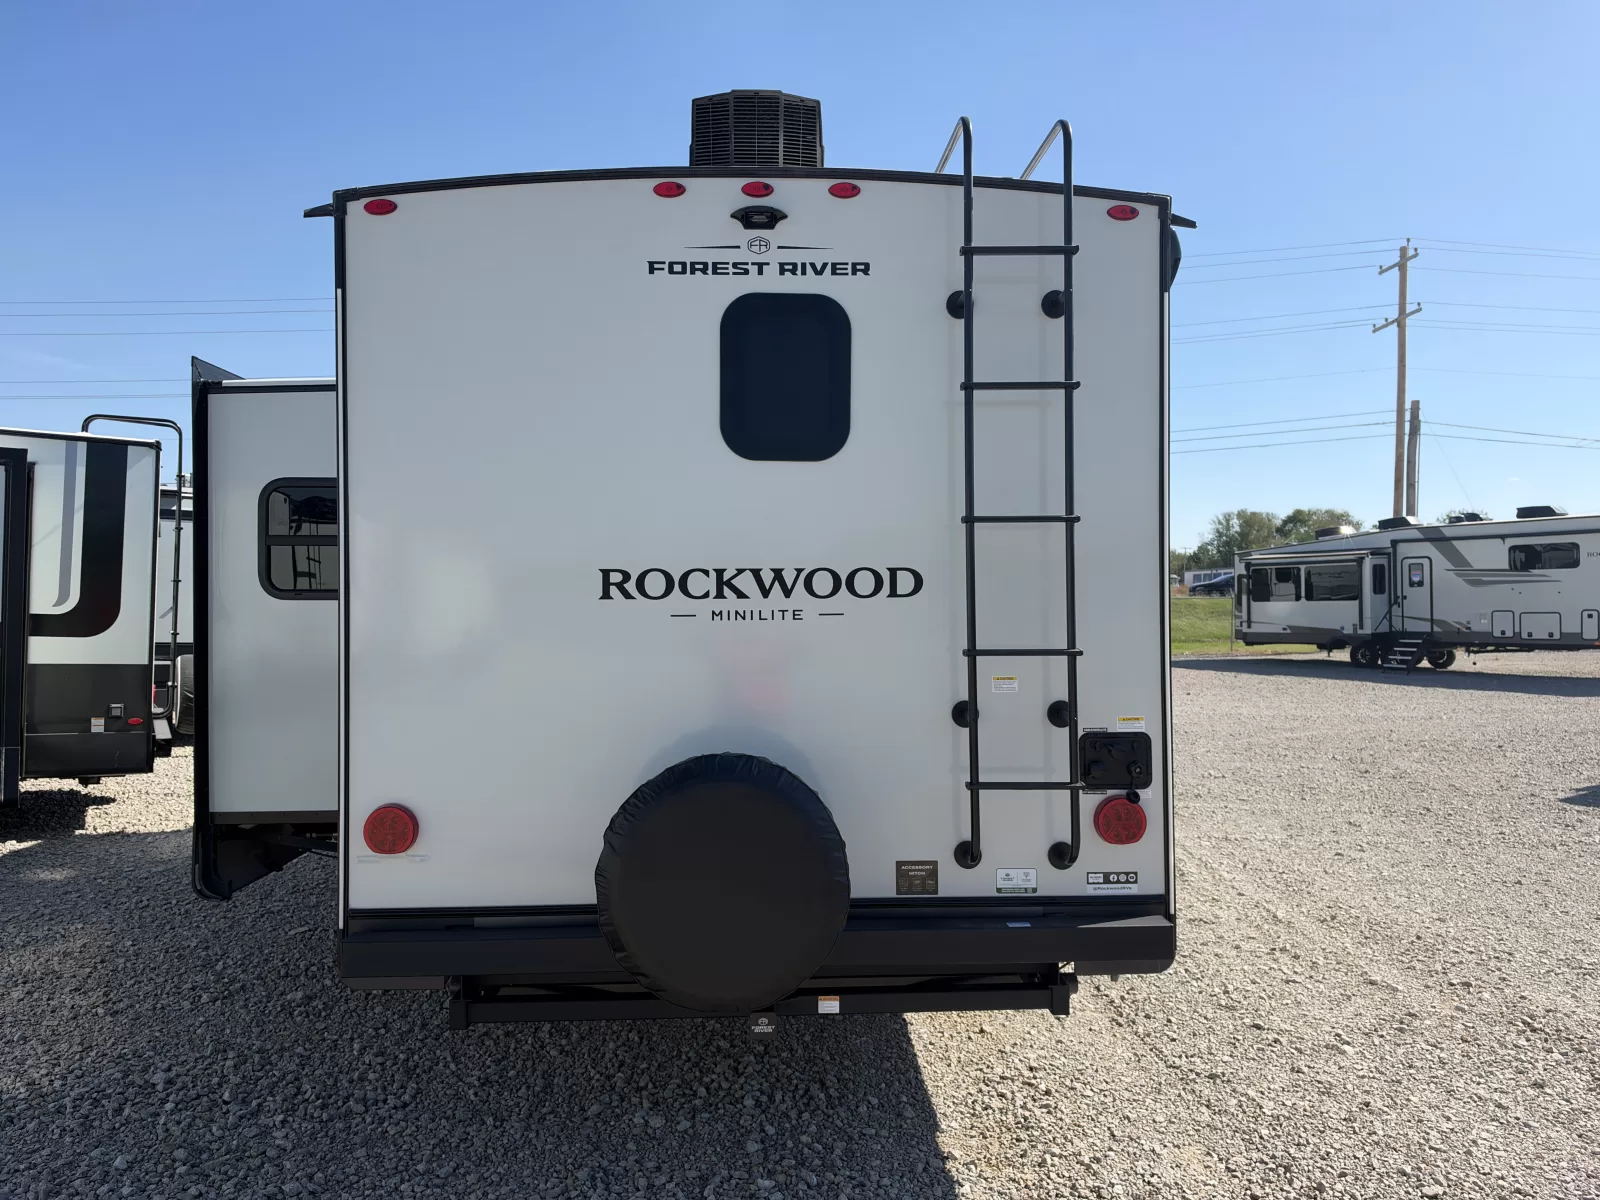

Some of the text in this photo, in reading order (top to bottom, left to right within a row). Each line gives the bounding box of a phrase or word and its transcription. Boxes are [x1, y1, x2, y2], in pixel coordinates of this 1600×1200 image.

[646, 260, 871, 276] FOREST RIVER
[598, 567, 924, 600] ROCKWOOD
[711, 609, 804, 621] MINILITE
